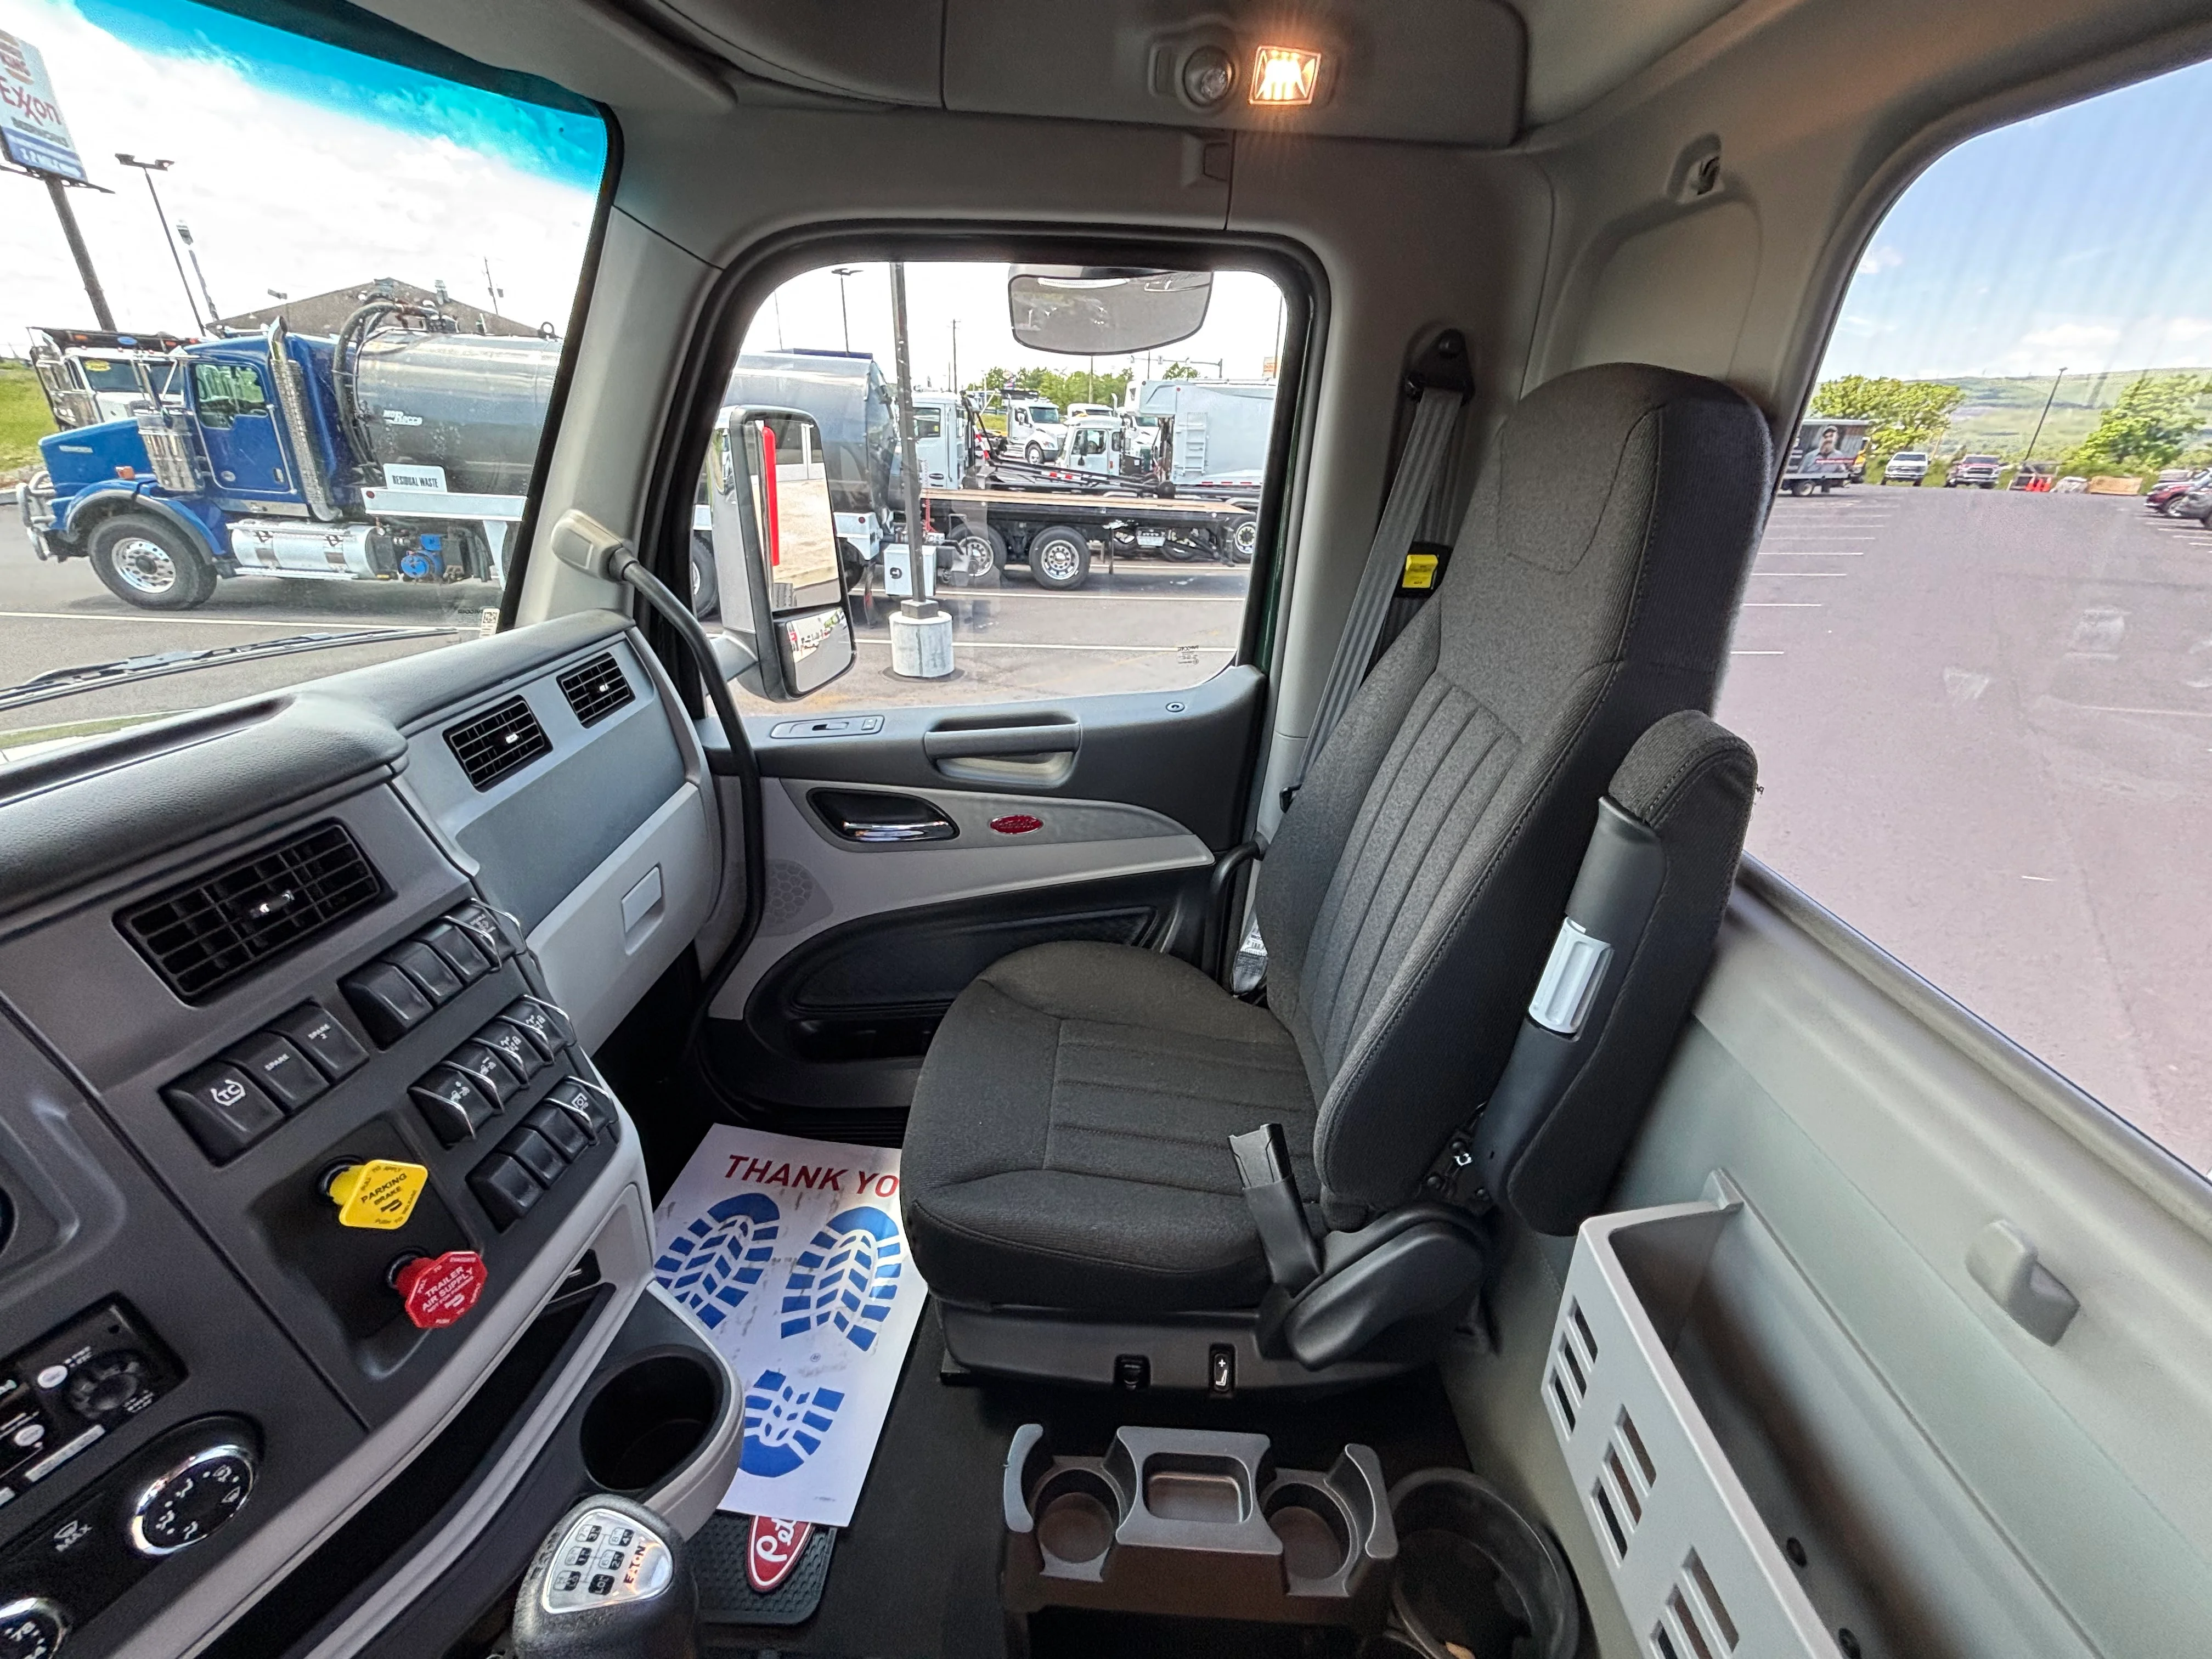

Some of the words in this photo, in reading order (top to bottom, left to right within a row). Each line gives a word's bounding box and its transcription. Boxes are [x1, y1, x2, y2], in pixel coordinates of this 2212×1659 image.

[392, 475, 419, 486] RESIDUAL
[419, 477, 439, 488] WASTE
[308, 1024, 330, 1040] SPARE
[264, 1053, 290, 1071] SPARE
[218, 1085, 240, 1099] TC
[360, 1173, 407, 1204] PARKING
[725, 1154, 849, 1191] THANK
[856, 1170, 899, 1198] YO
[374, 1186, 403, 1205] BRAKE
[422, 1295, 439, 1312] AIR
[439, 1267, 473, 1297] SUPPLY
[425, 1266, 464, 1297] TRAILER
[55, 1523, 93, 1552] MAX
[757, 1517, 797, 1562] Pet
